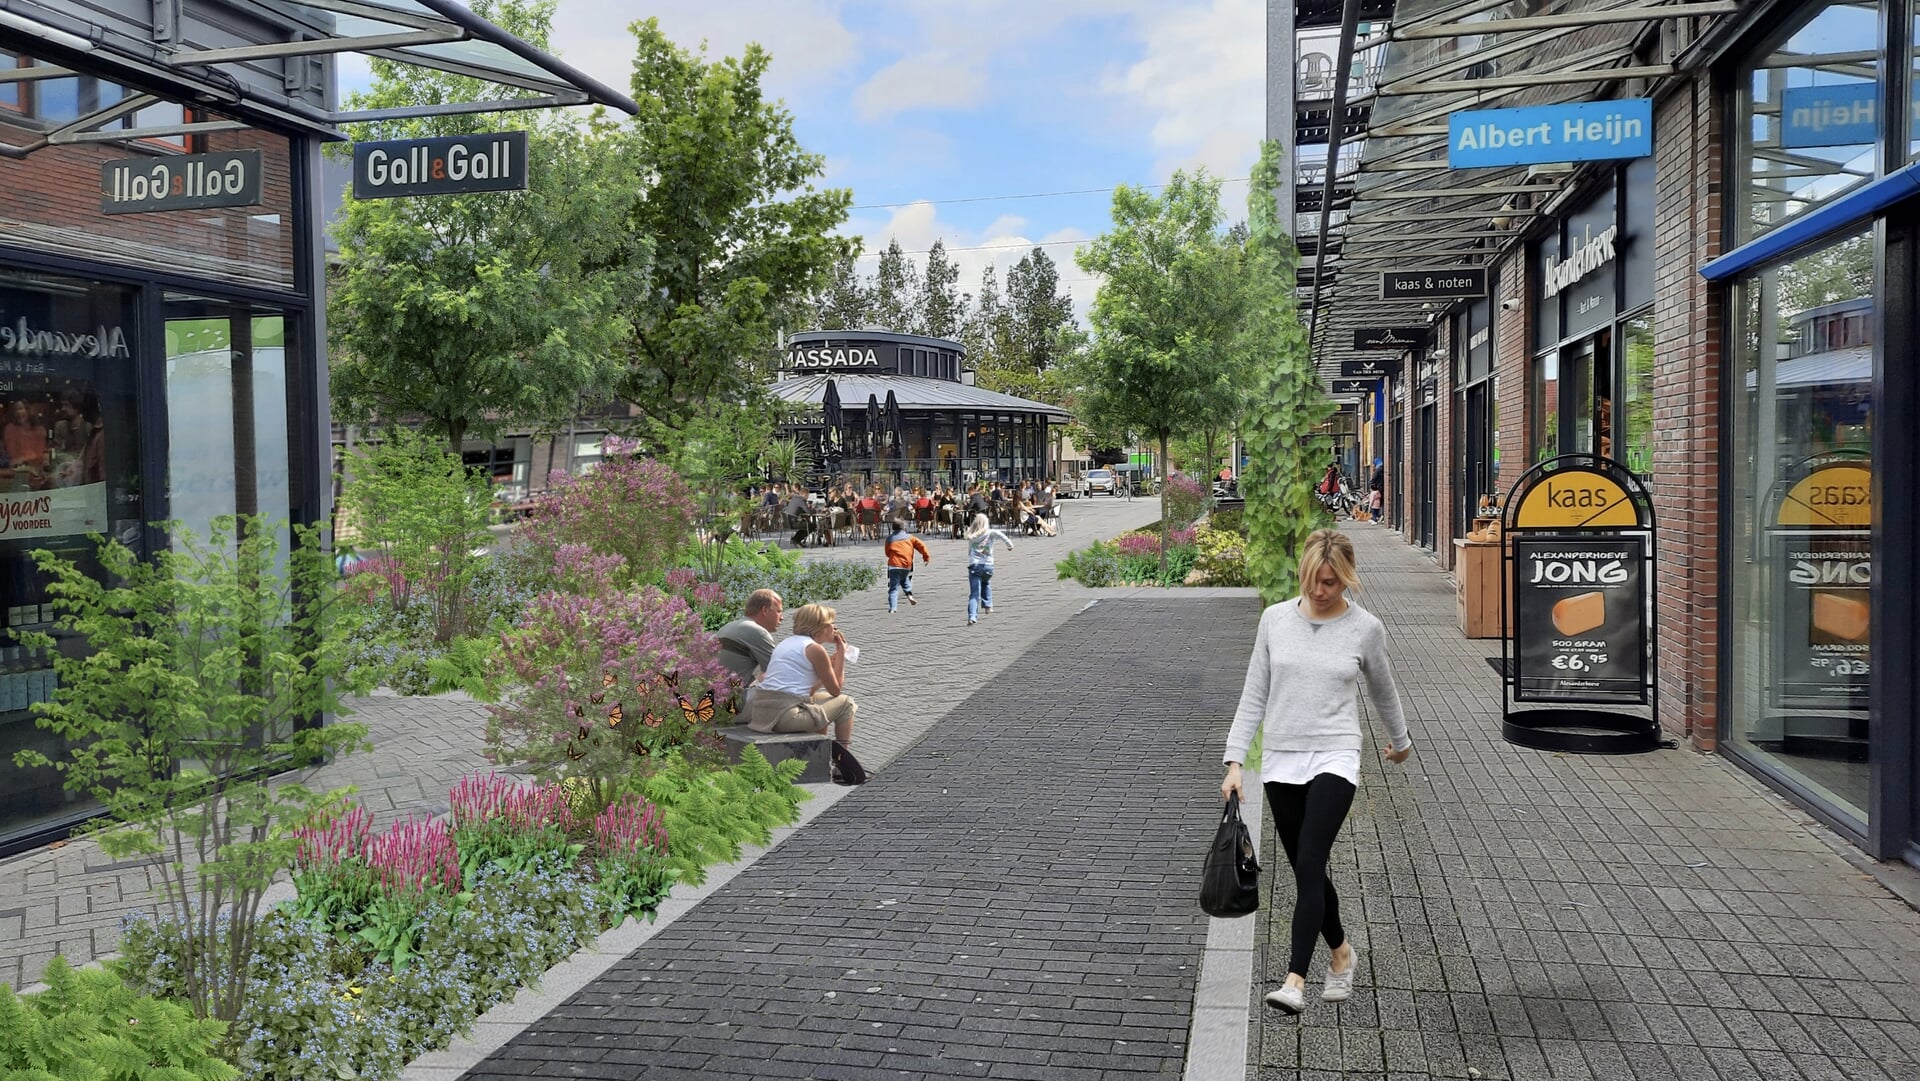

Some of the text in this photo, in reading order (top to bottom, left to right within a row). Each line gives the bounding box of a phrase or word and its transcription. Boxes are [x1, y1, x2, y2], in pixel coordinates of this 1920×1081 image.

[1457, 113, 1642, 151] Albert Heijn
[1394, 276, 1473, 291] kaas & noten
[1548, 481, 1608, 508] kaas
[12, 519, 52, 531] VOORDEEL
[1530, 552, 1629, 560] ALEXANDERHOEVE
[1530, 560, 1629, 583] JONG
[1552, 640, 1607, 648] 500 GRAM
[1551, 653, 1608, 673] €6,95
